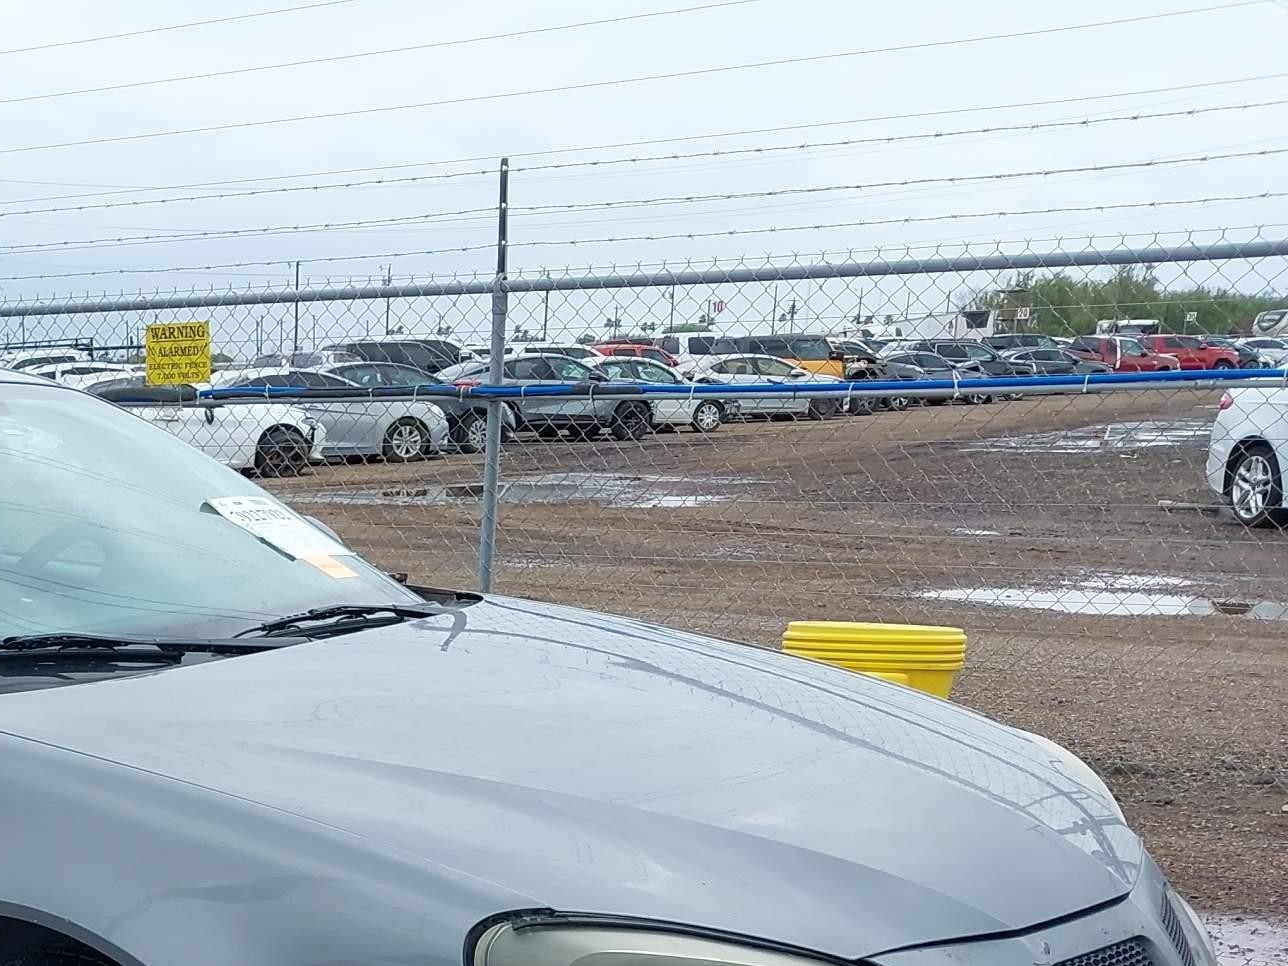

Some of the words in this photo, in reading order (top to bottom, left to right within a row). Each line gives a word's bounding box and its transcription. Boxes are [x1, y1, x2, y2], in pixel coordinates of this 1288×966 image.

[712, 301, 724, 313] 10
[150, 325, 205, 339] WARNING
[157, 346, 199, 357] ALARMED
[149, 362, 182, 370] ELECTRIC
[184, 361, 208, 369] FENCE
